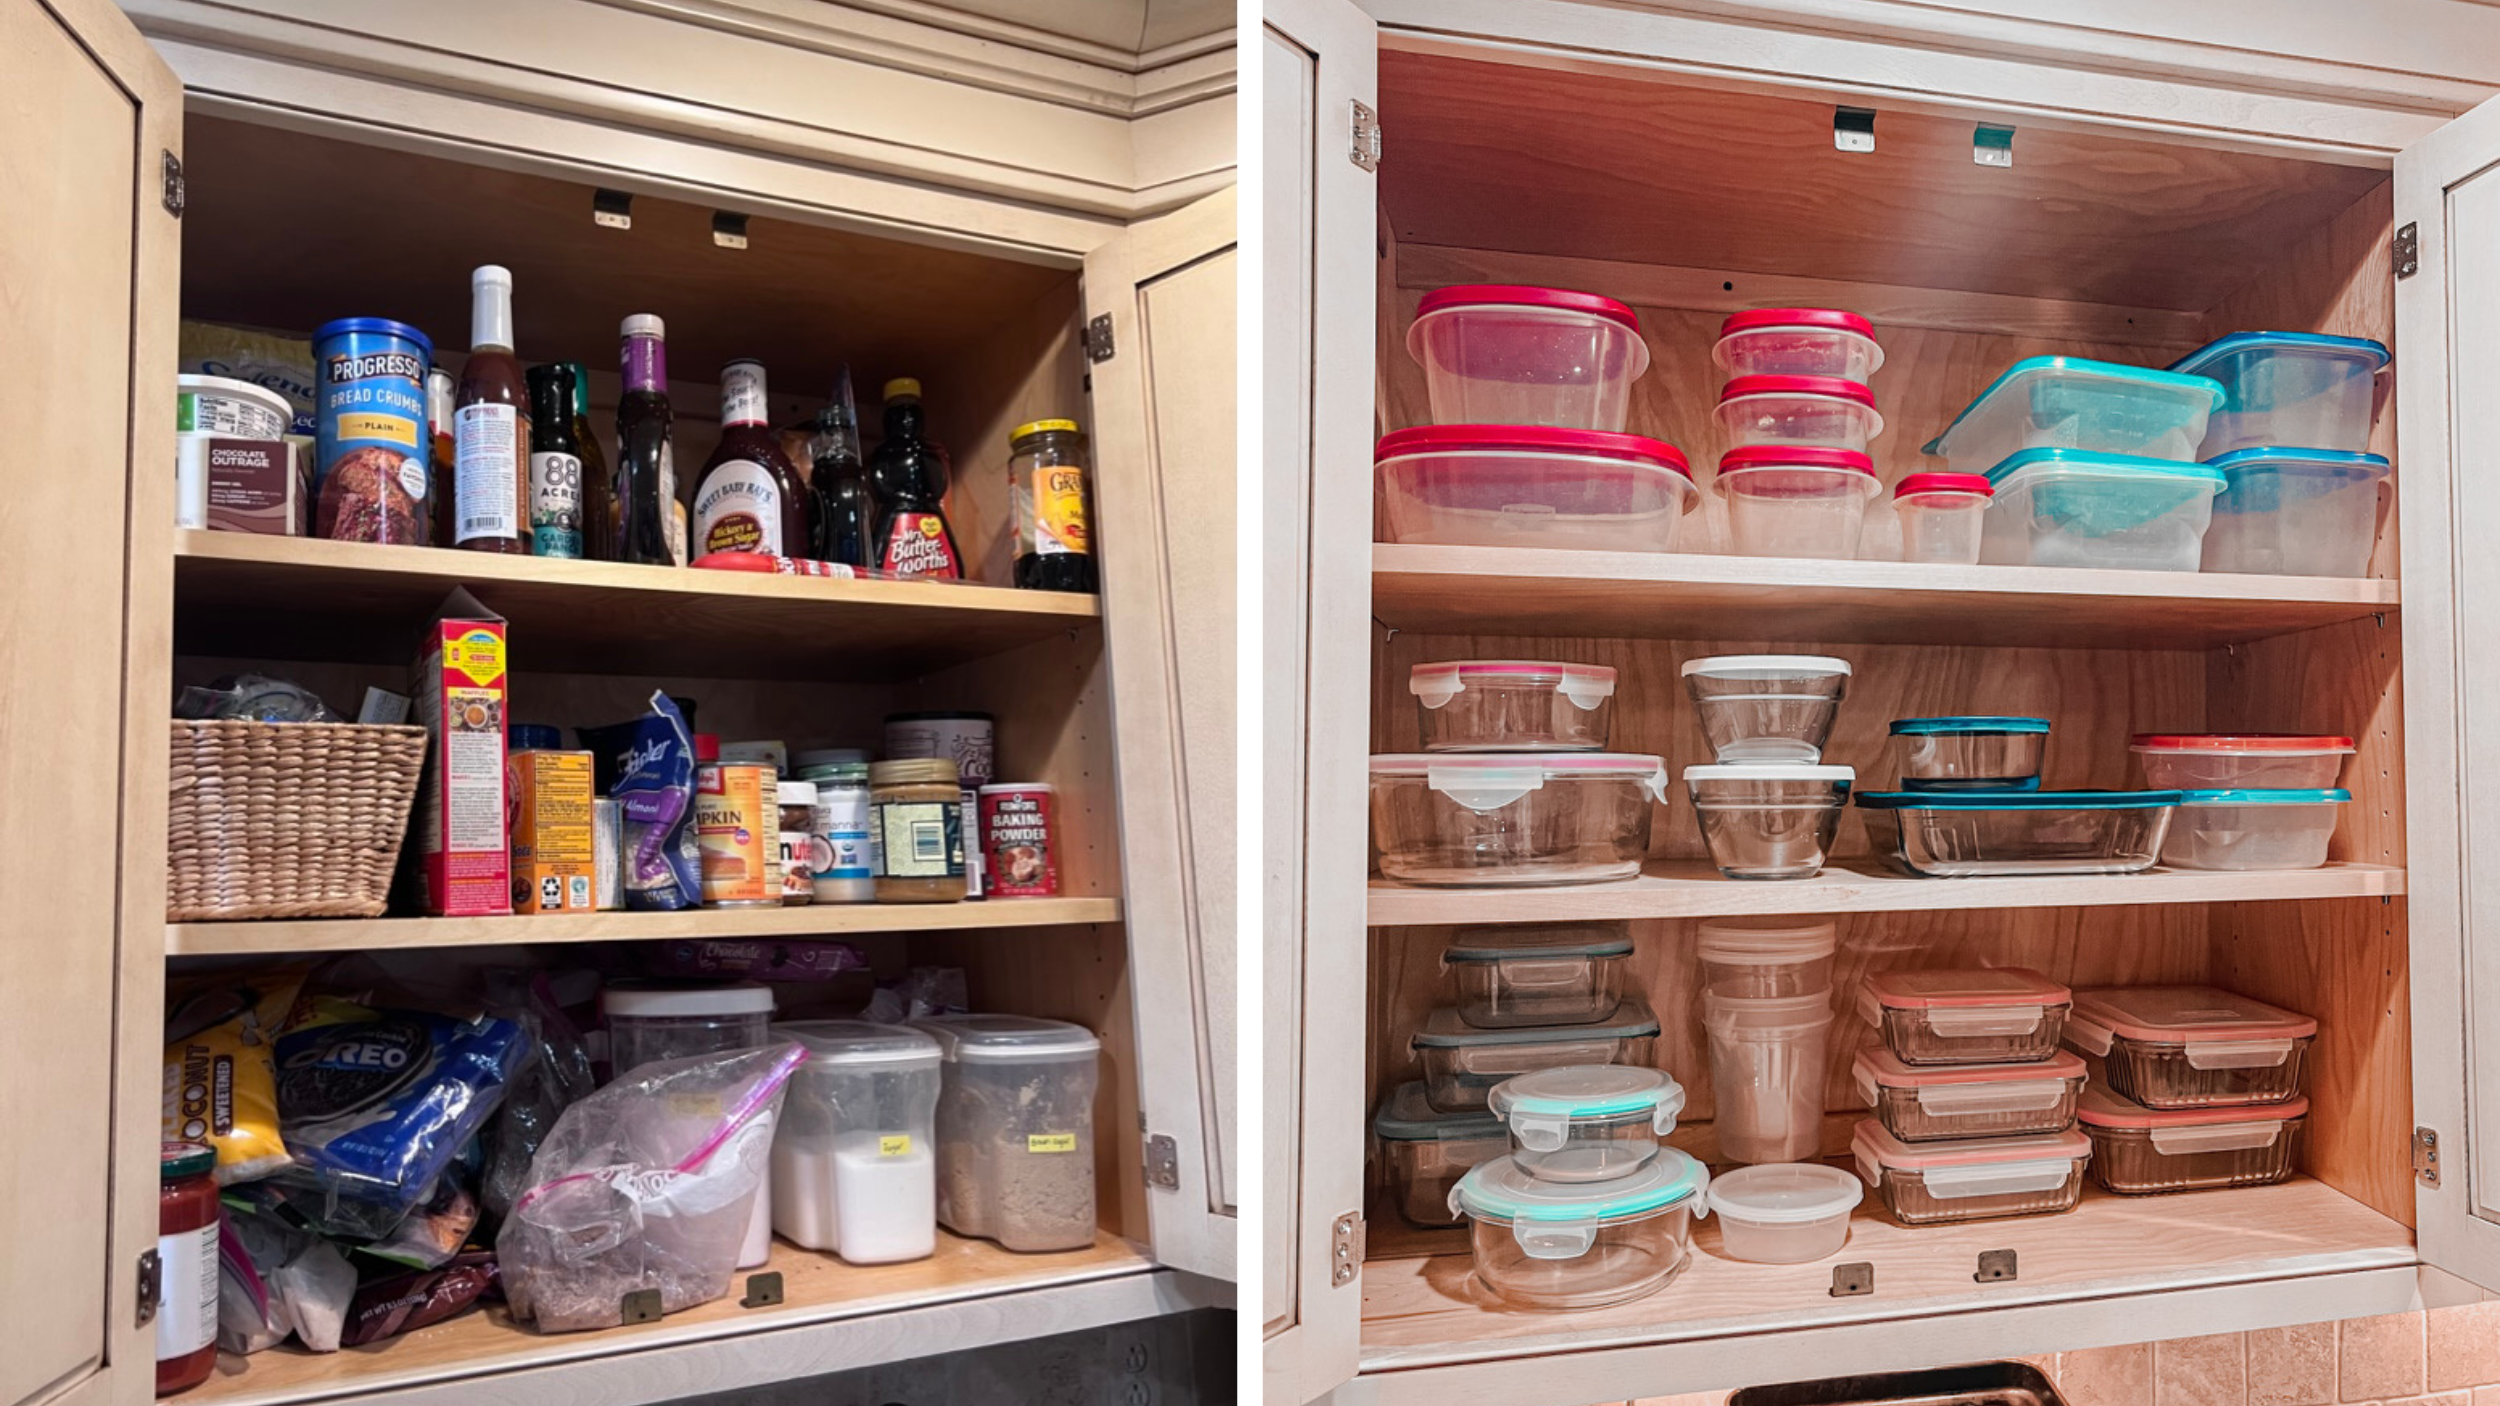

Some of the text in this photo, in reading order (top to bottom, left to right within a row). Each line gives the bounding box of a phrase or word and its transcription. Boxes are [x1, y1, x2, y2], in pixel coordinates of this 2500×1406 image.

[333, 355, 420, 381] PROGRESSO
[330, 388, 422, 416] BREAD CRUMBS
[364, 422, 394, 431] PLAIN
[211, 449, 266, 459] CHOCOLATE
[211, 457, 270, 468] OUTRAGE
[545, 456, 579, 489] 88
[698, 481, 773, 518] SWEET BABY RAY'S
[709, 531, 760, 549] Brown Sugar
[714, 524, 746, 538] Hickory
[697, 811, 742, 825] PKIN
[992, 813, 1044, 827] BAKING
[990, 828, 1047, 842] POWDER
[283, 1041, 408, 1069] OREO
[182, 1044, 210, 1144] OCONUT
[215, 1061, 232, 1127] SWEETENED
